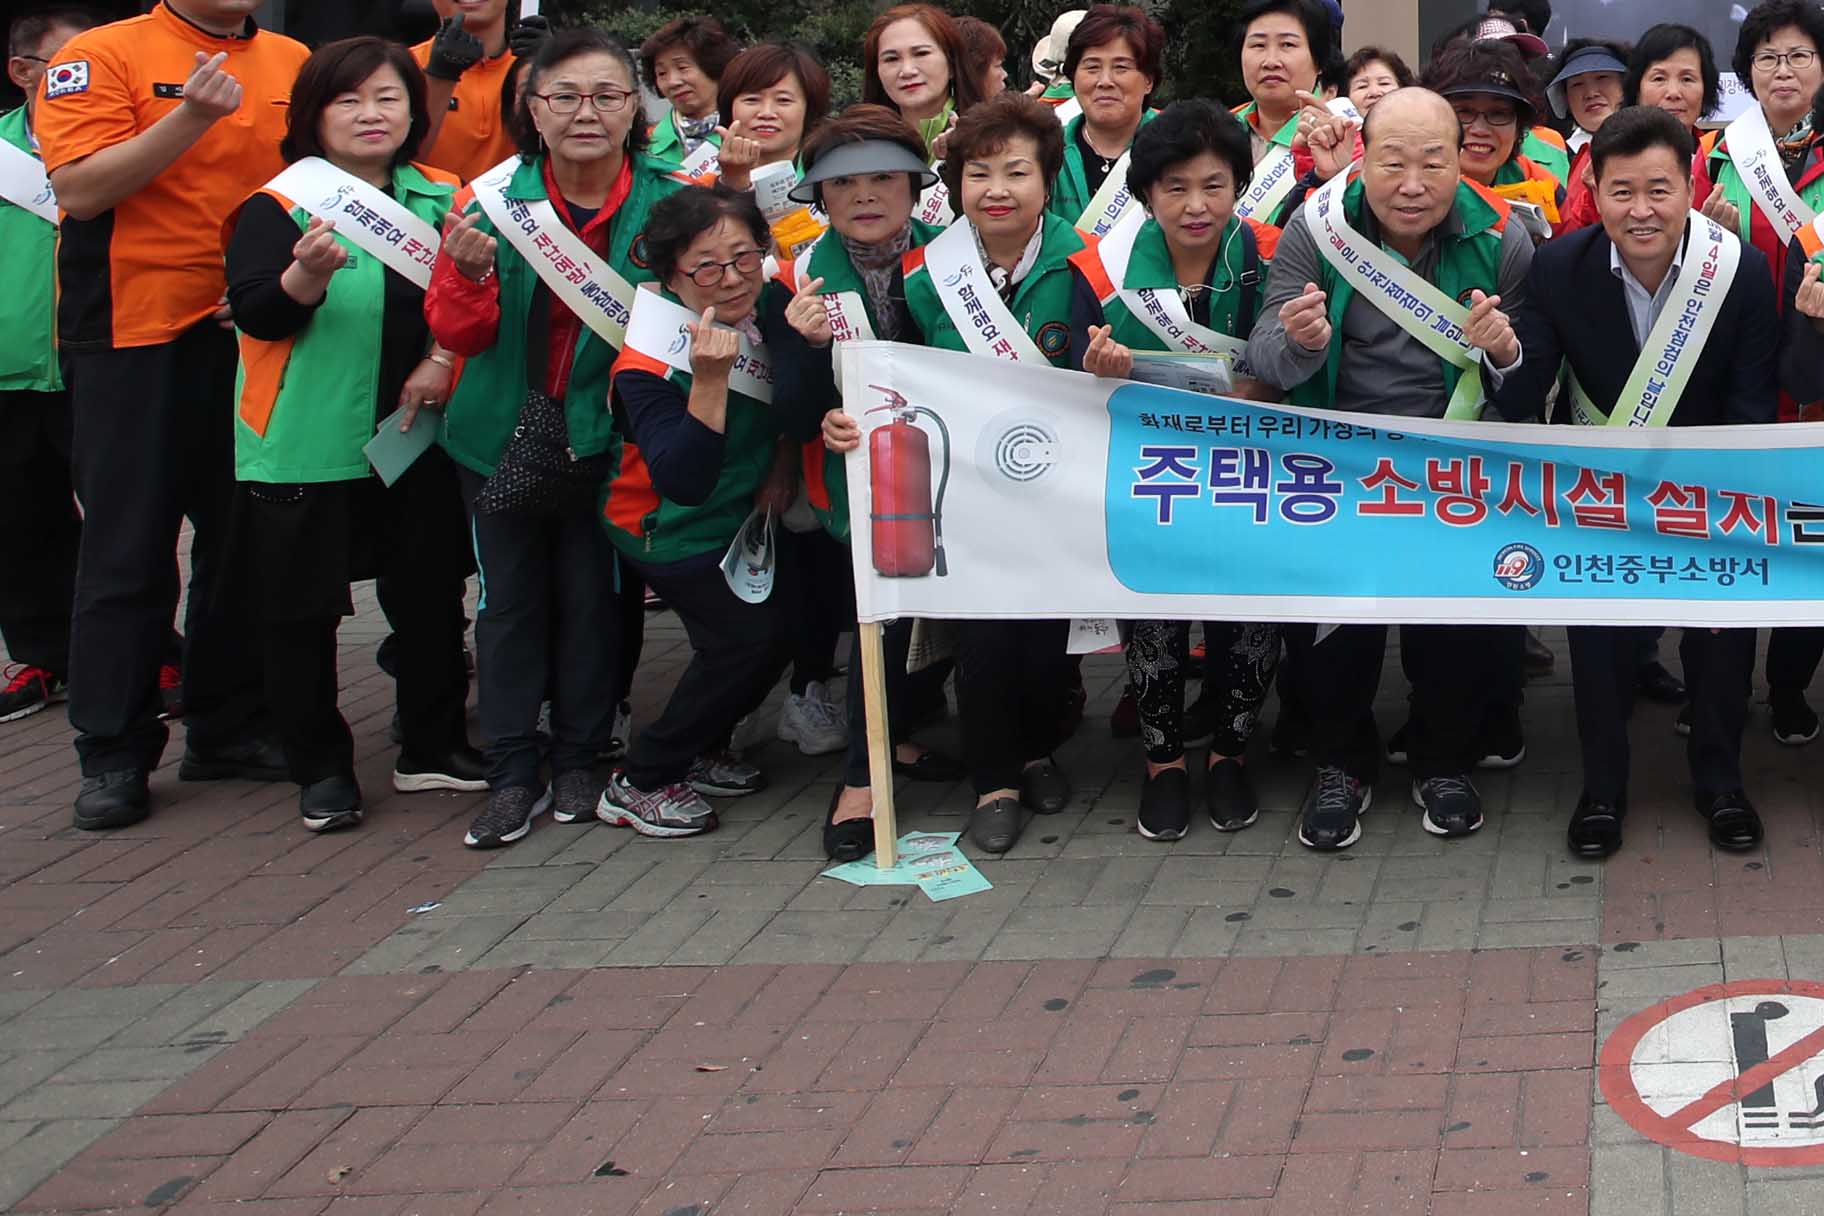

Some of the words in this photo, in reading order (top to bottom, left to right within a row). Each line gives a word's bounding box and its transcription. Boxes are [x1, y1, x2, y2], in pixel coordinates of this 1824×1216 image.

[1754, 165, 1786, 213] 함께해요
[344, 200, 406, 246] 함께해요
[533, 233, 592, 284] 재난예방!
[581, 281, 630, 328] 동참해요
[1357, 261, 1433, 321] 안전점검의
[1693, 246, 1717, 296] 4일은
[958, 284, 1000, 341] 함께해요
[1655, 299, 1702, 377] 안전점검의
[1138, 412, 1250, 437] 화재로부터
[1257, 416, 1301, 440] 우리
[1131, 445, 1344, 525] 주택용
[1357, 454, 1628, 533] 소방시설
[1552, 553, 1770, 587] 인천중부소방서
